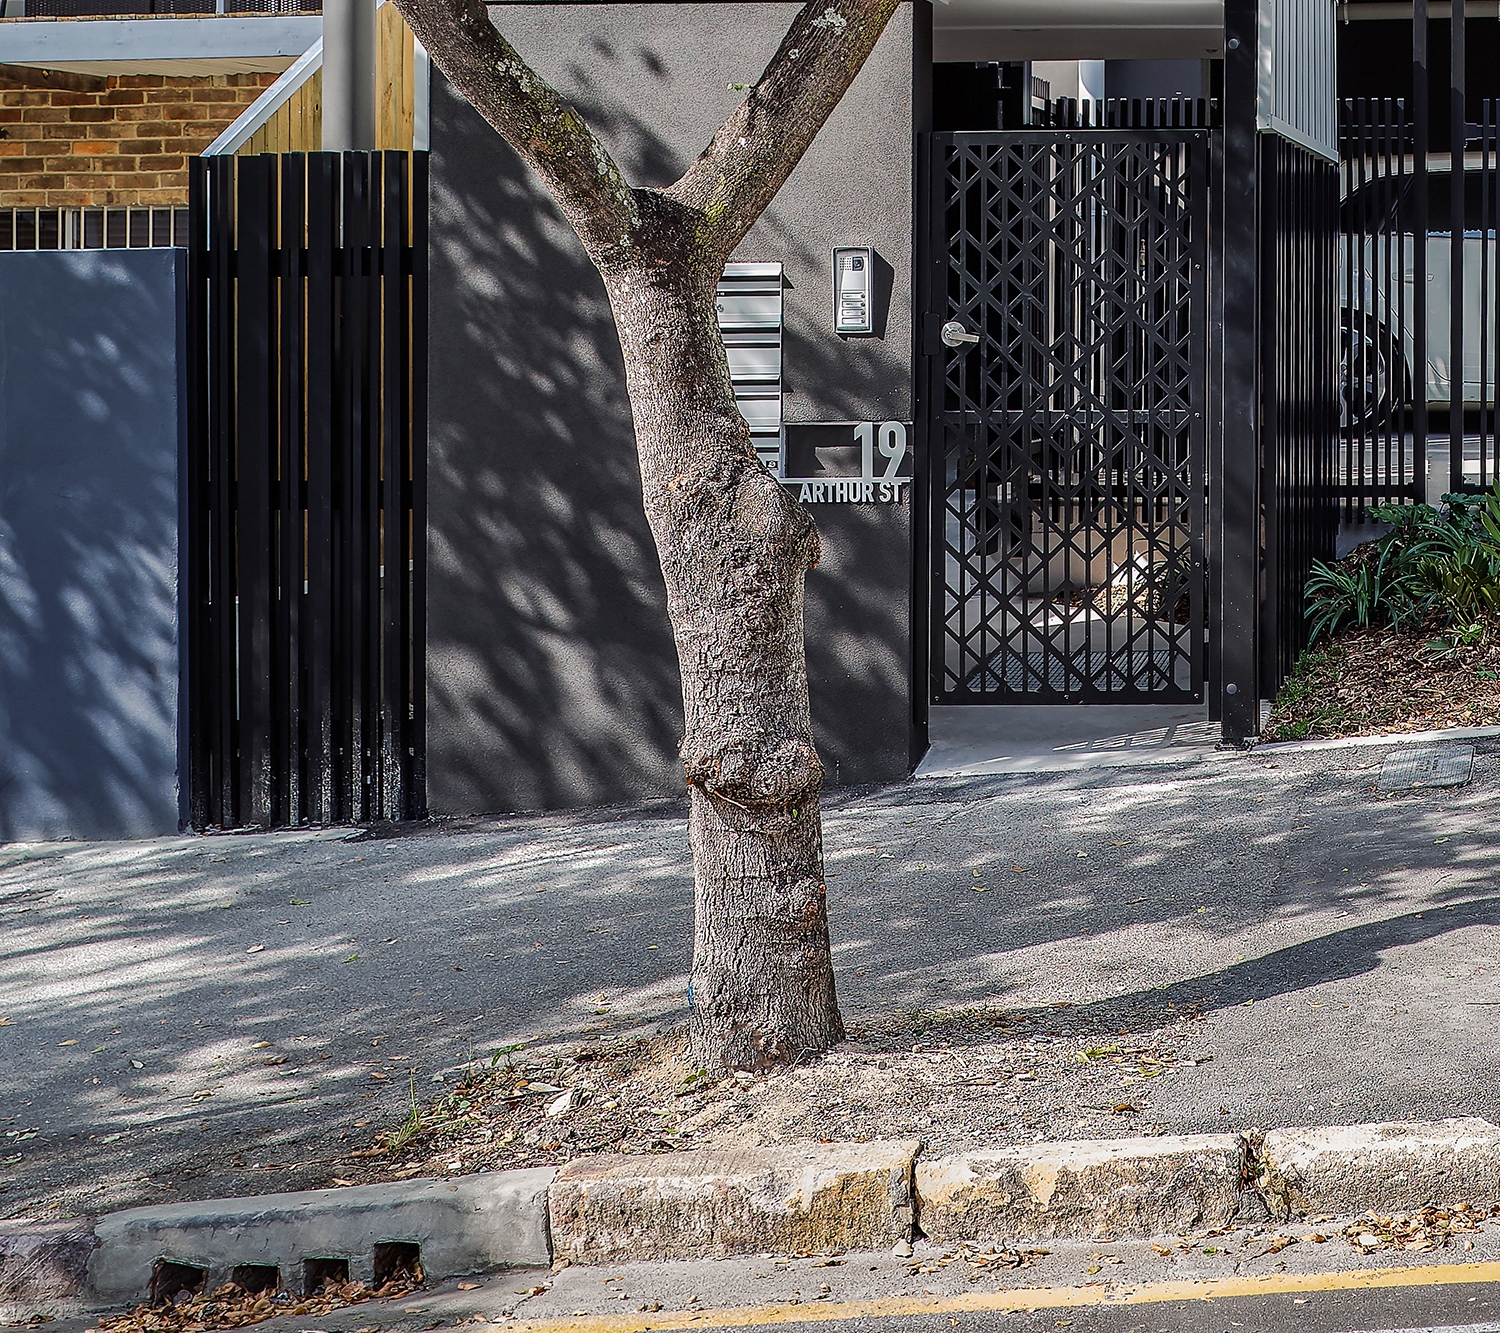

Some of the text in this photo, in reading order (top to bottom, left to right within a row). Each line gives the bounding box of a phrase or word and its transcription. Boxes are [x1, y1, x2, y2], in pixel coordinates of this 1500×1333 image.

[854, 421, 907, 479] 19
[799, 482, 902, 503] ARTHUR ST
